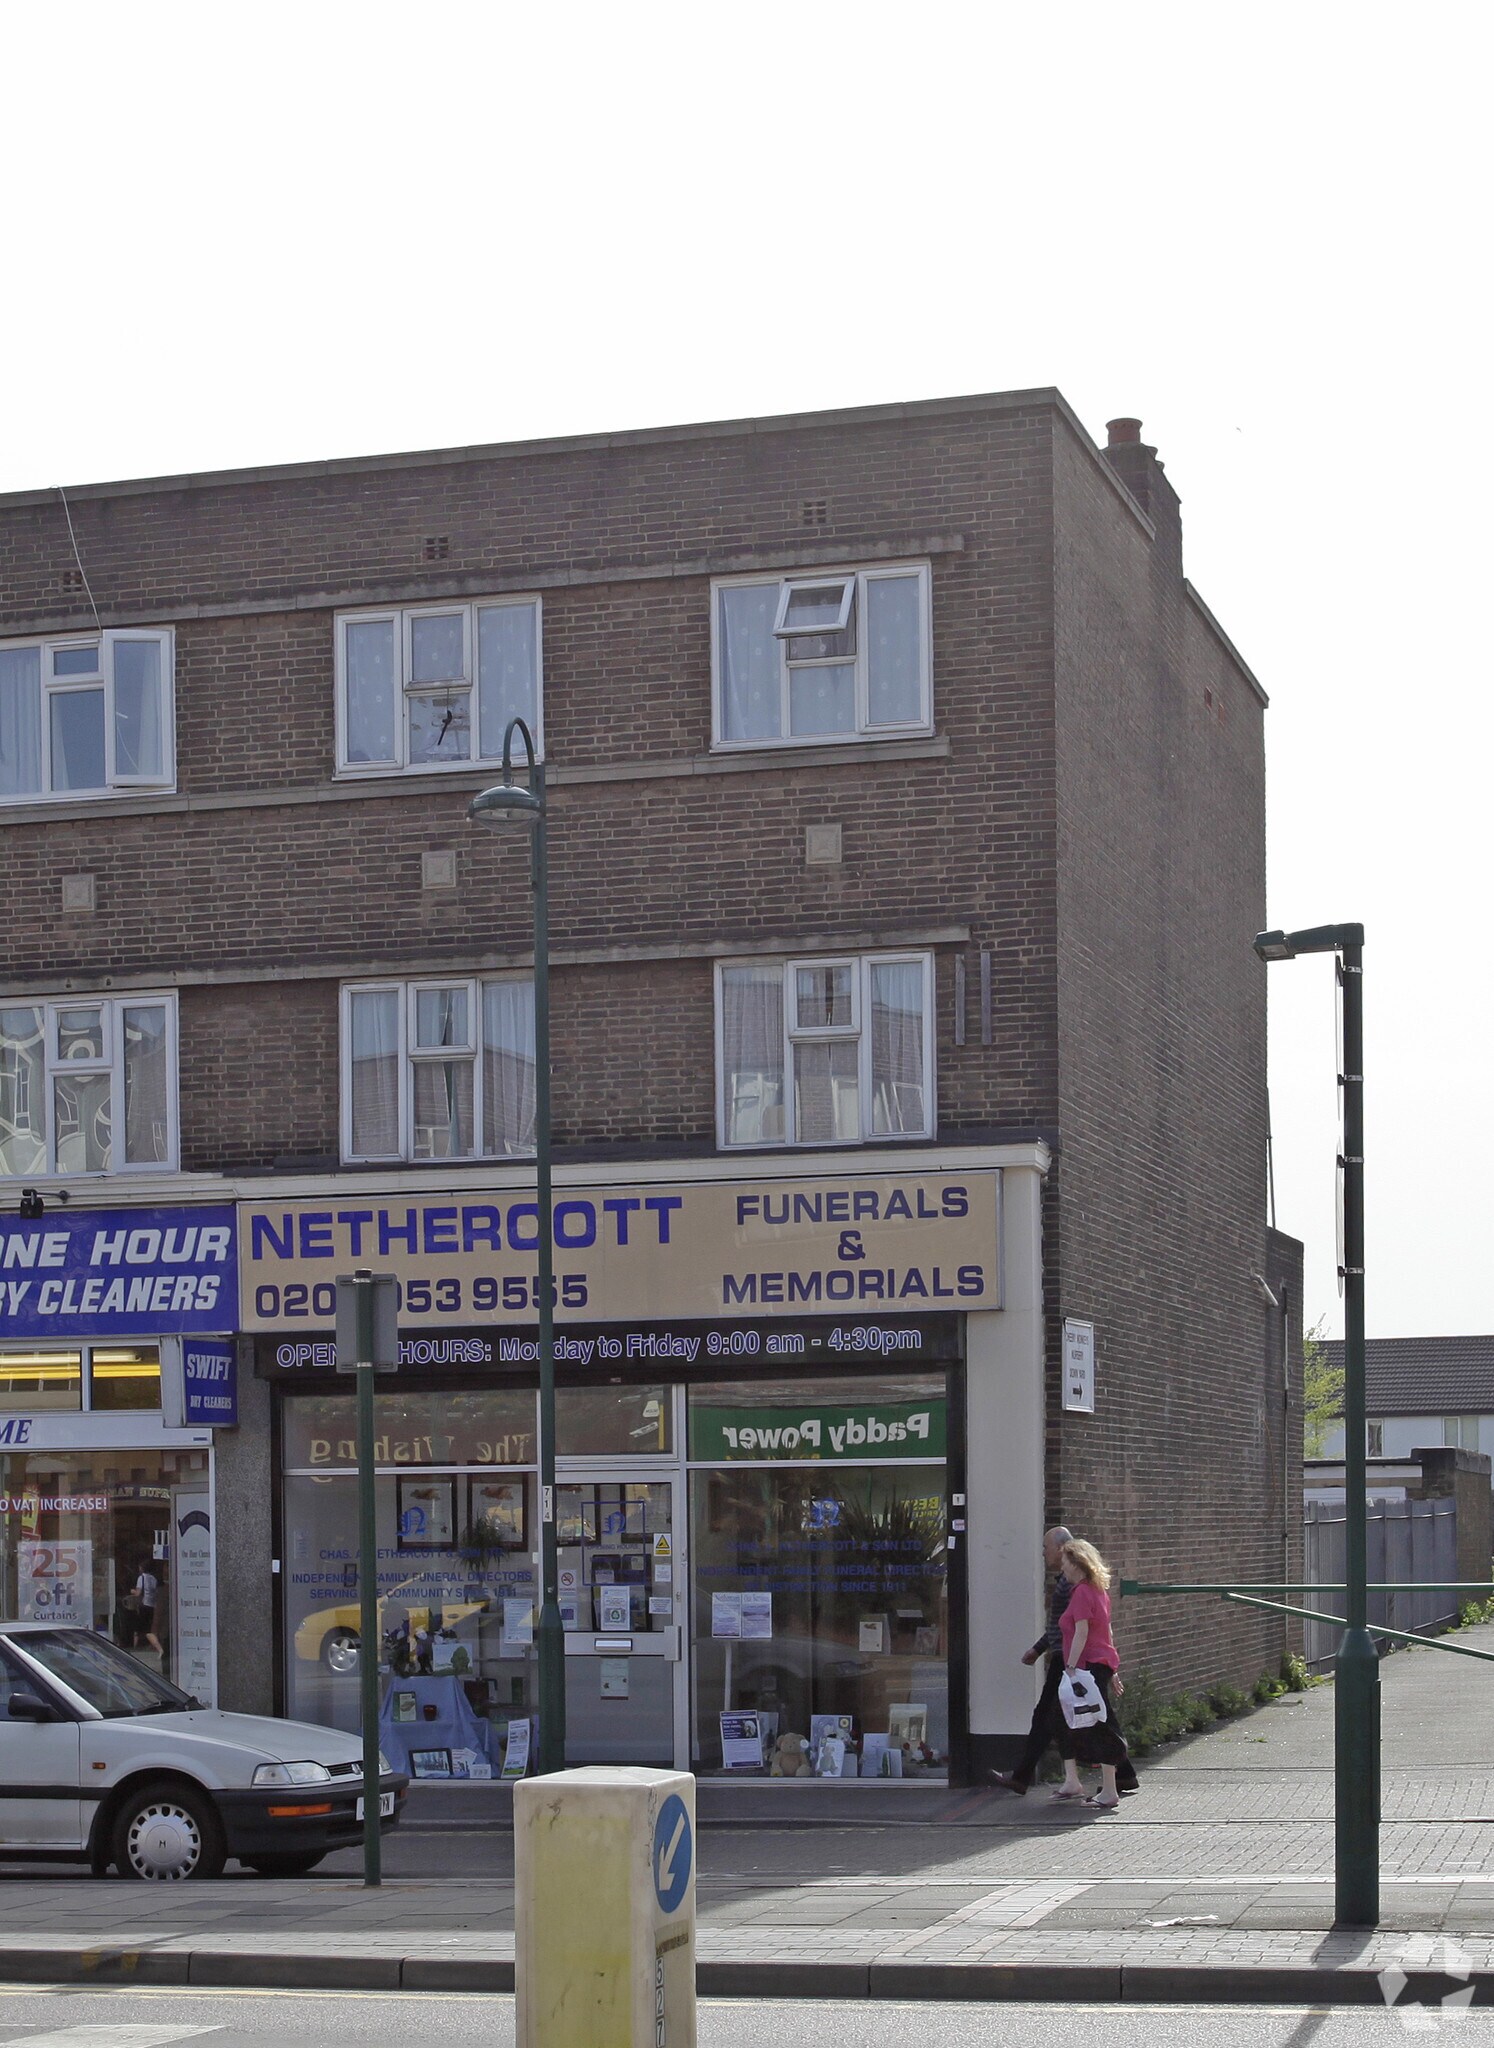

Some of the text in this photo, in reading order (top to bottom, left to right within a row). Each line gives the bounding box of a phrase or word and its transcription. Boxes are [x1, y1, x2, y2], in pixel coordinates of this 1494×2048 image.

[736, 1186, 969, 1225] FUNERALS
[251, 1196, 682, 1261] NETHERCOTT
[0, 1226, 232, 1268] NE HOUR
[838, 1230, 866, 1261] &
[0, 1275, 220, 1317] Y CLEANERS
[723, 1265, 984, 1304] MEMORIALS
[255, 1283, 337, 1318] 020
[362, 1279, 461, 1313] 53
[398, 1337, 491, 1364] HOURS:
[500, 1335, 595, 1364] Moday
[598, 1335, 622, 1358] to
[626, 1333, 700, 1362] Friday
[707, 1331, 760, 1355] 9:00
[766, 1333, 804, 1353] am
[828, 1326, 922, 1355] 4:30pm
[187, 1353, 232, 1380] SWIFT
[203, 1396, 232, 1410] CLEANERS
[12, 1499, 36, 1512] VAT
[41, 1498, 108, 1511] INCREASE!
[372, 1549, 441, 1560] ETHERCOTT
[292, 1572, 361, 1584] INDEPENDEN
[413, 1571, 464, 1583] FUNERAL
[467, 1571, 532, 1583] DIRECTORS
[842, 1582, 876, 1592] SINCE
[36, 1582, 75, 1607] off
[310, 1588, 358, 1599] SERVING
[387, 1588, 453, 1599] COMMUNITY
[33, 1610, 78, 1620] Curtains
